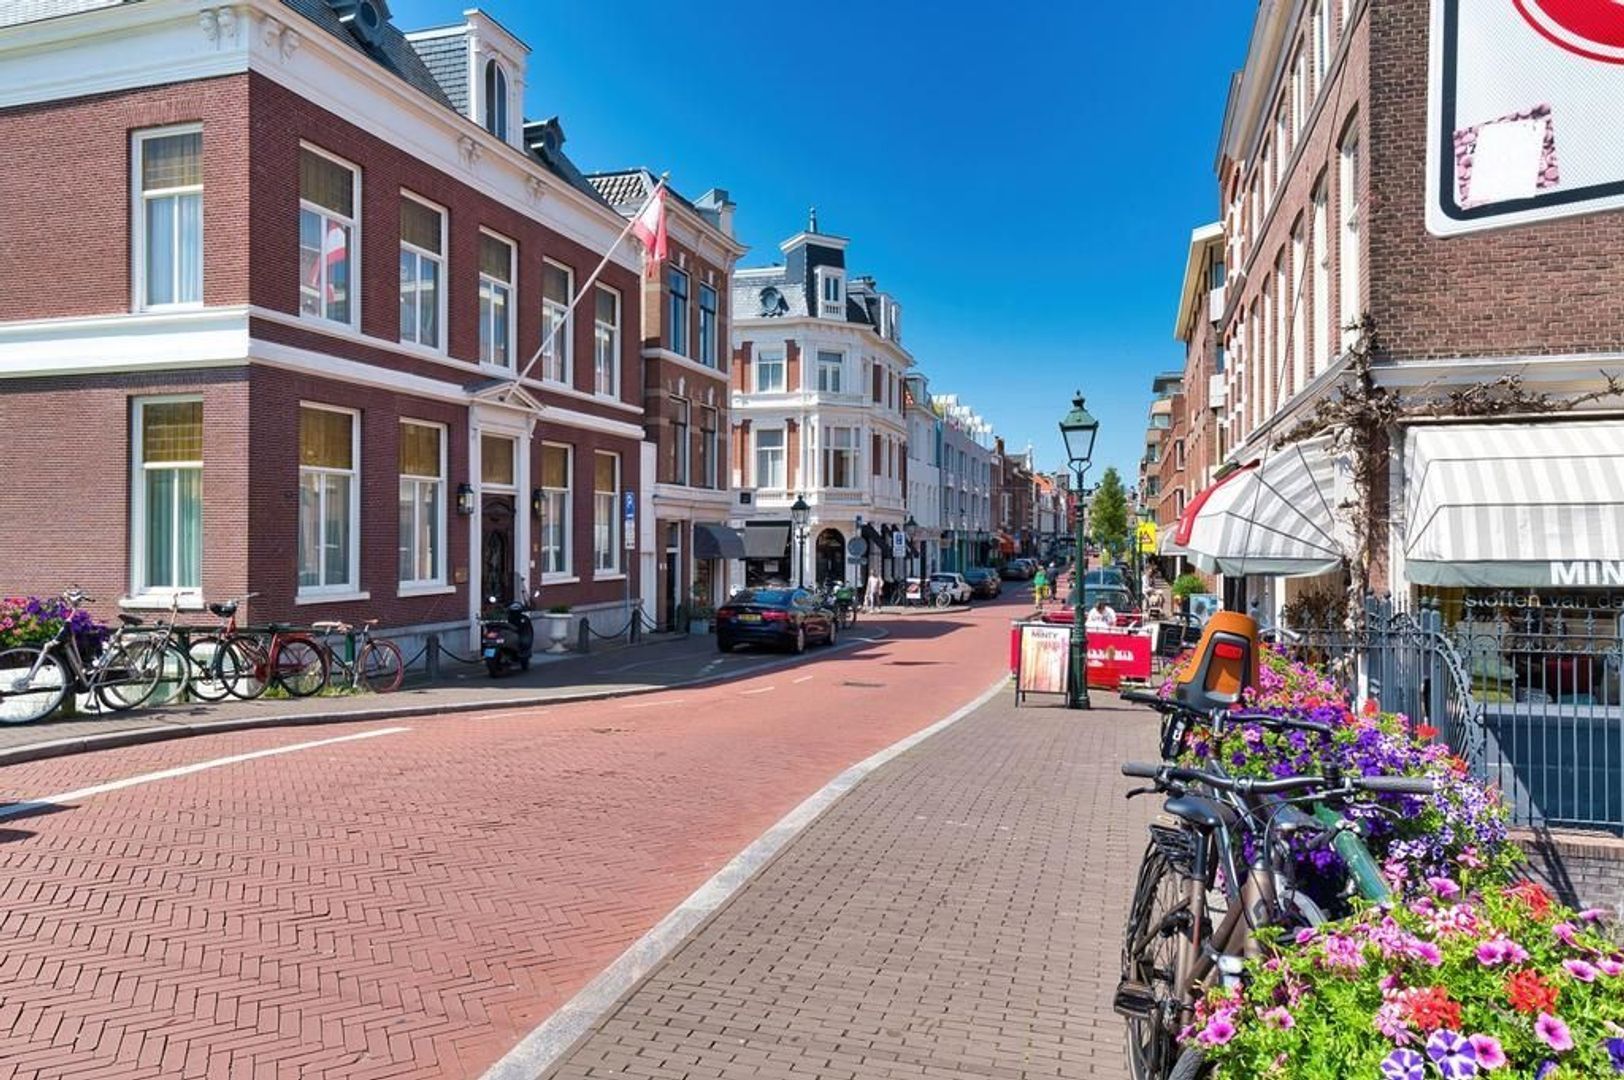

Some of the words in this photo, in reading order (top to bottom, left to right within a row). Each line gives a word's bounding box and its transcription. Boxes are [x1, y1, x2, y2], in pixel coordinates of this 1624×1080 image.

[1550, 562, 1624, 585] MIN
[1464, 589, 1541, 607] stoffen
[1549, 594, 1588, 608] van
